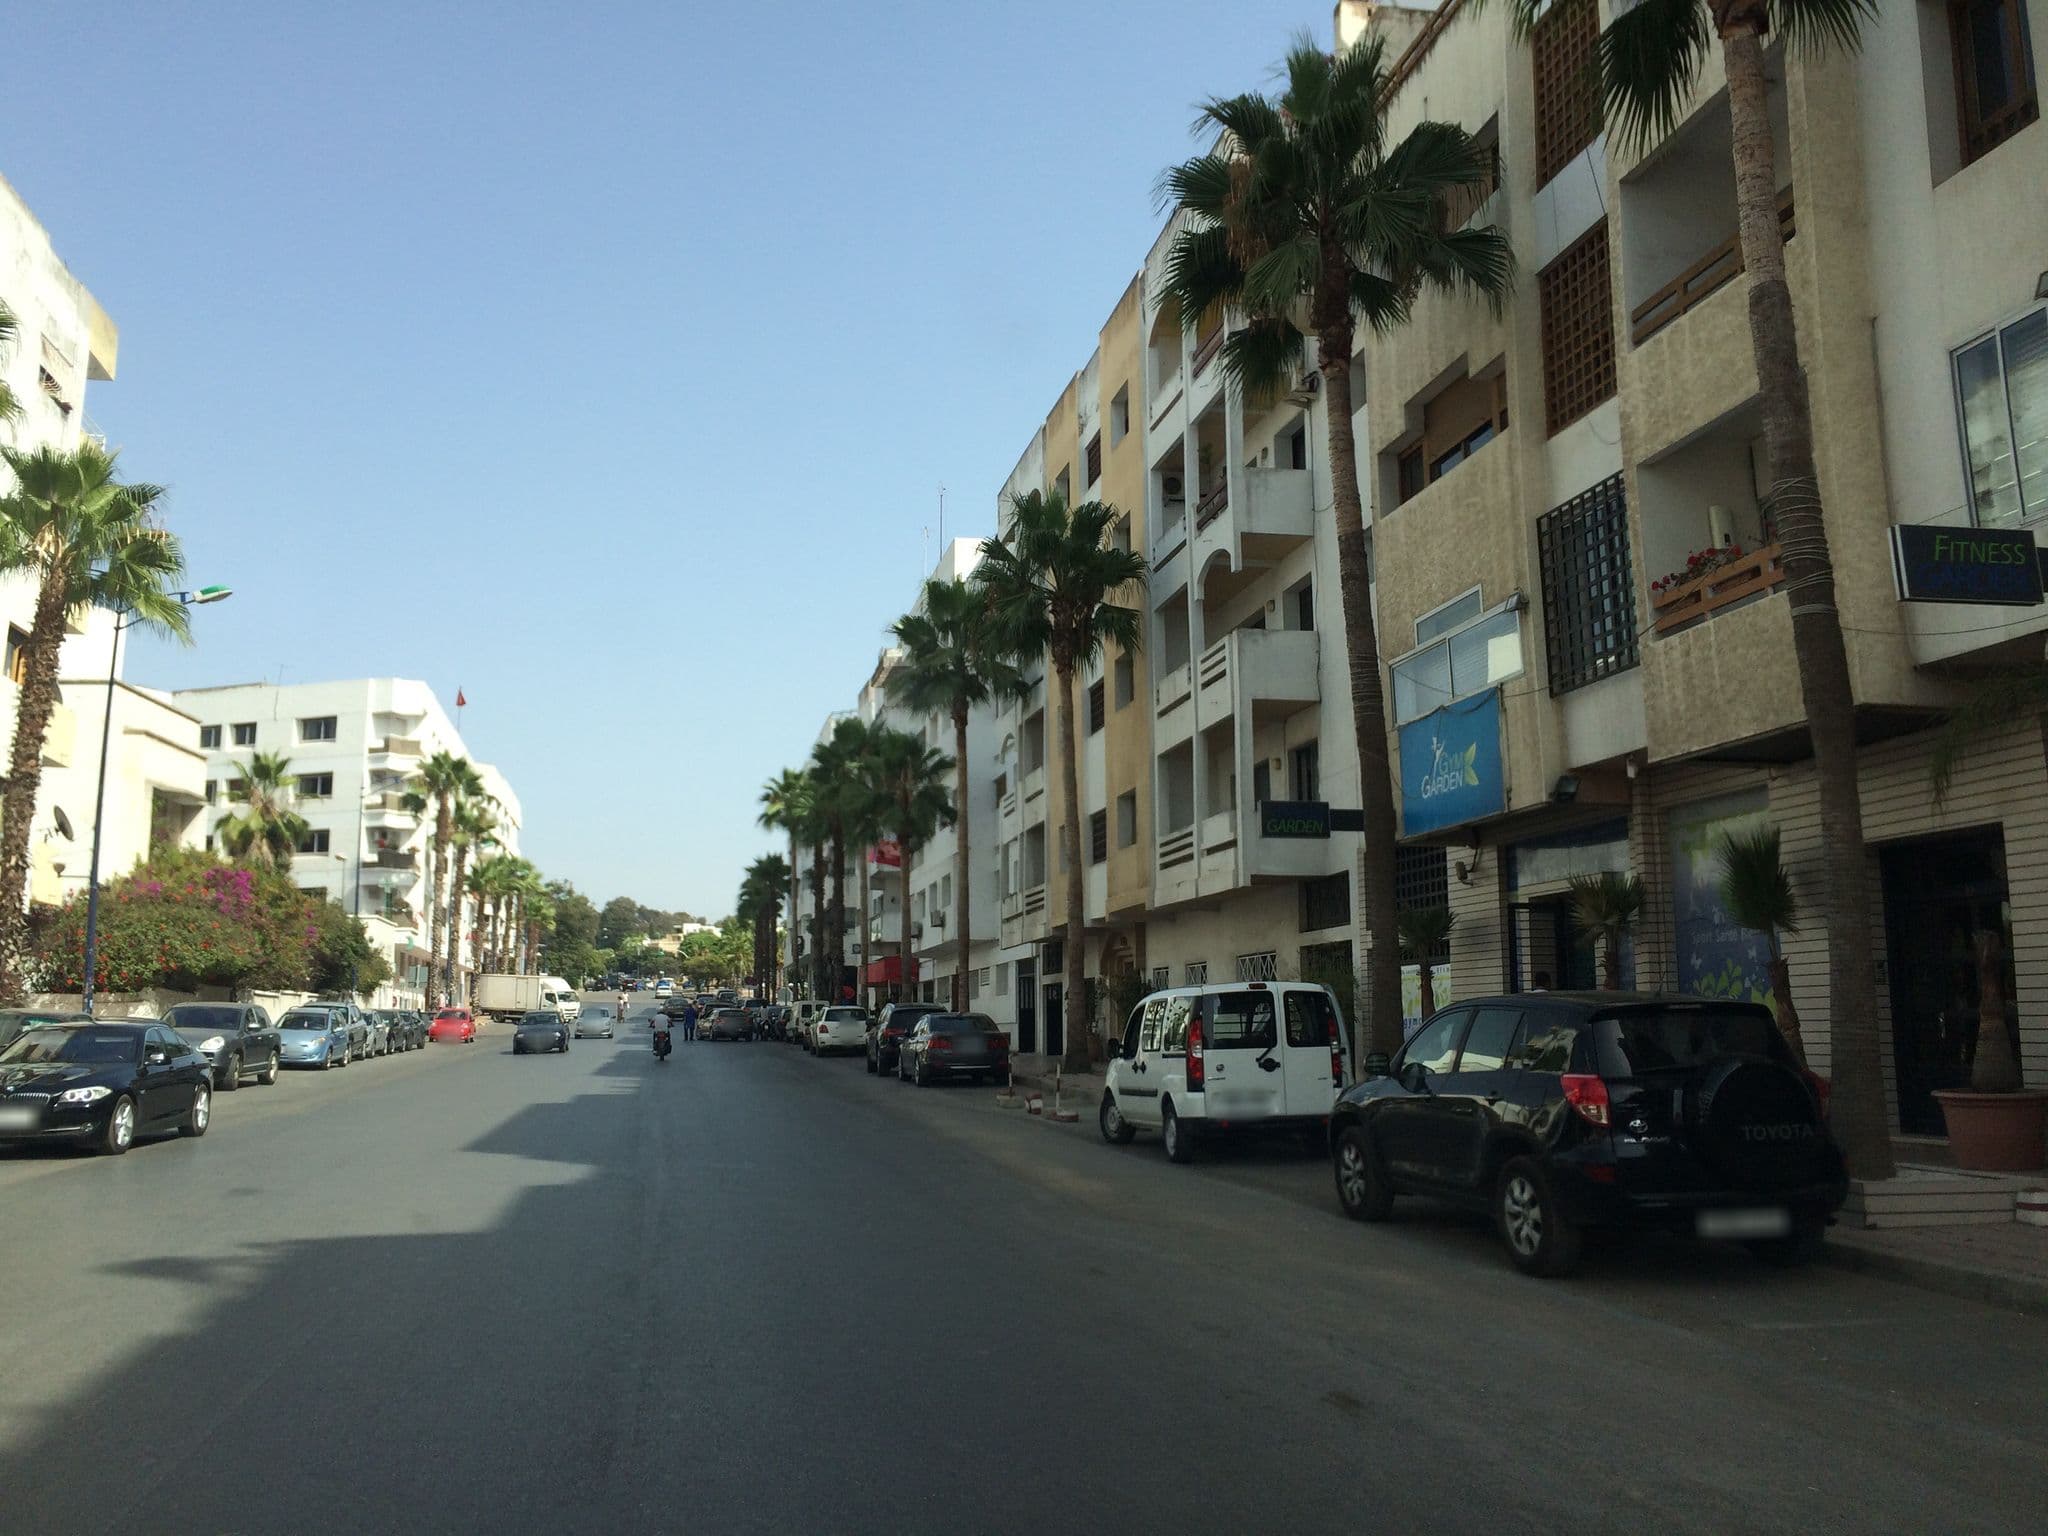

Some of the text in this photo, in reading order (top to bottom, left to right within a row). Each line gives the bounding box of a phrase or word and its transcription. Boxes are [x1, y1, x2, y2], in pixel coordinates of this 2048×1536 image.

[1935, 535, 2025, 564] FITNESS
[1440, 751, 1463, 775] GYM
[1421, 769, 1464, 799] GARDEN
[1266, 818, 1324, 833] GARDEN
[1742, 1124, 1813, 1141] TOYOTA
